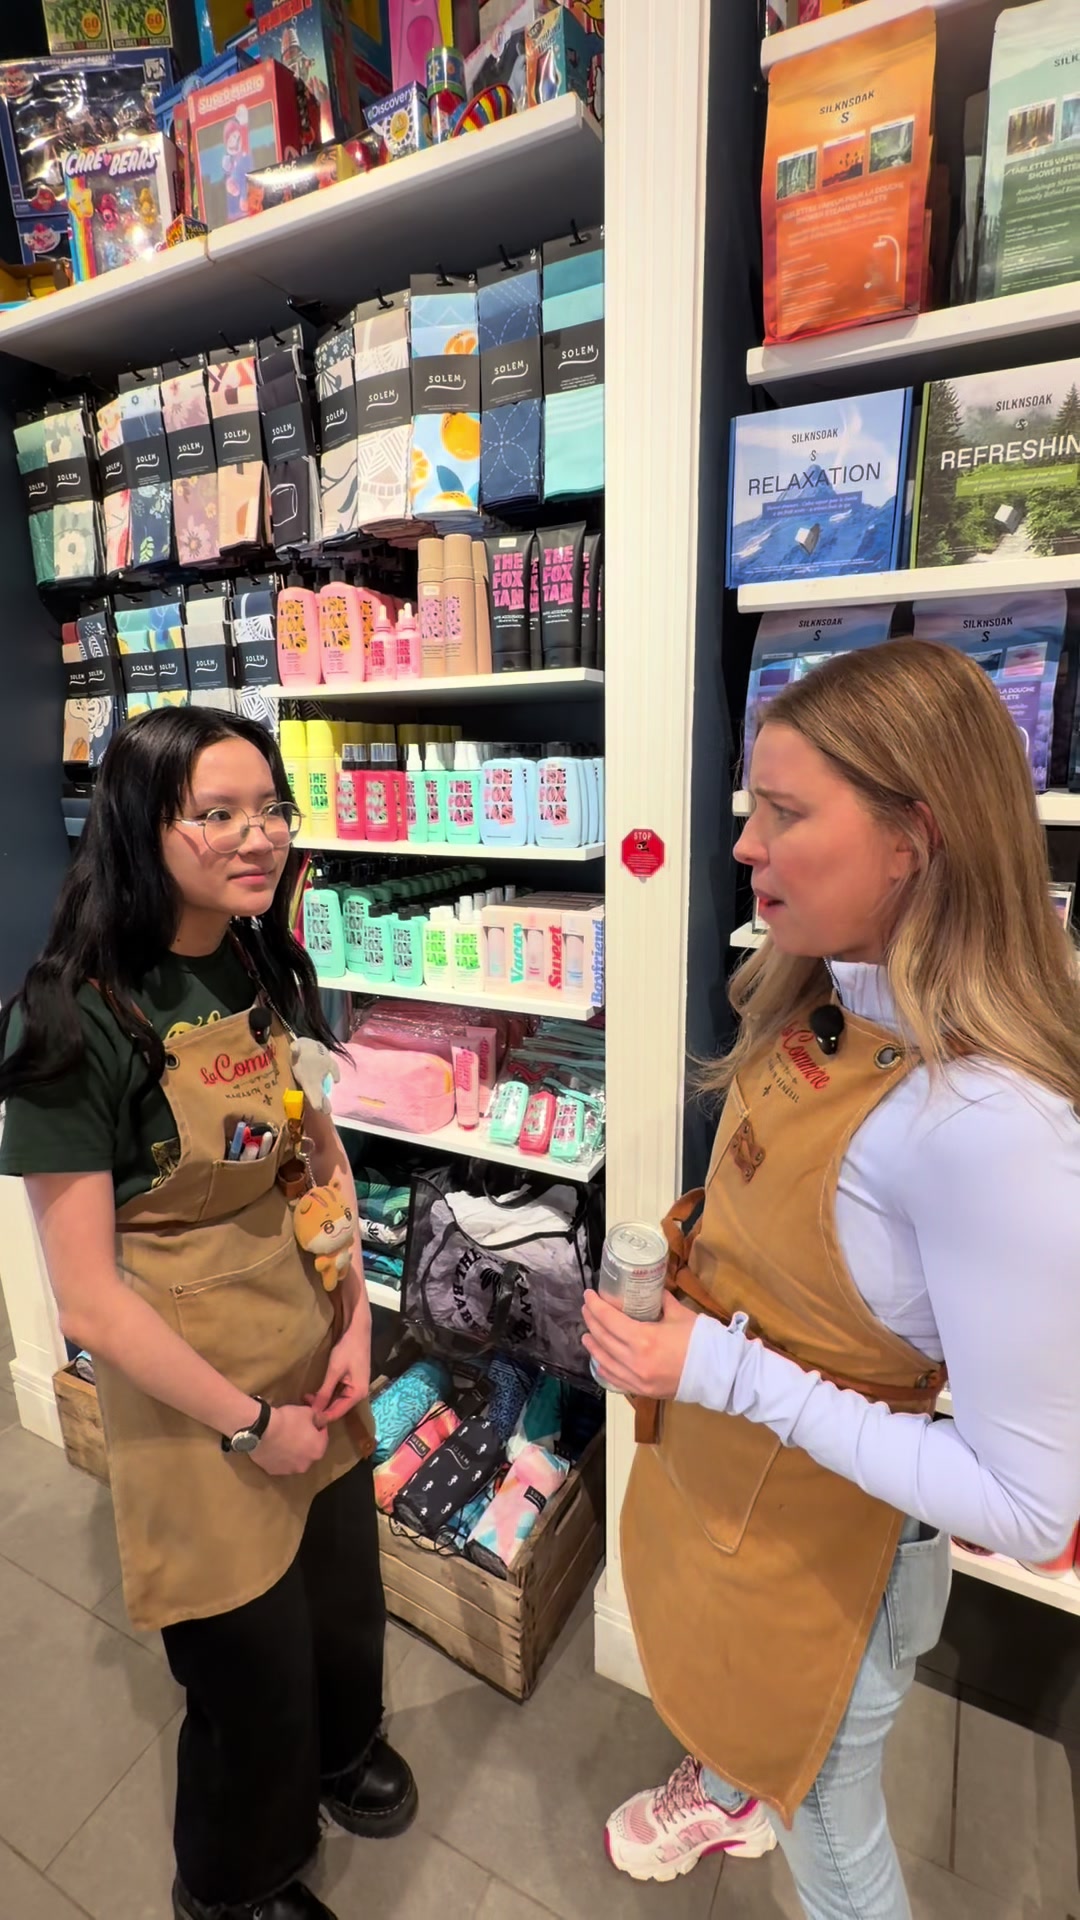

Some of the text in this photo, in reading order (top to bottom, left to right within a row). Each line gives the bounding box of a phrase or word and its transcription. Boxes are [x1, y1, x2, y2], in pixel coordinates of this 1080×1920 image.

[371, 88, 413, 117] Discovery
[820, 90, 875, 115] SILKNSOAK
[66, 146, 160, 176] CARE BEARS
[561, 345, 594, 359] SOLEM
[494, 360, 524, 375] SOLEM
[428, 374, 461, 384] SOLEM
[369, 389, 396, 402] SOLEM
[995, 393, 1053, 412] SILKNSOAK
[325, 408, 345, 423] SOLEM
[224, 430, 248, 440] SOLEM
[272, 423, 293, 436] SOLEM
[791, 428, 839, 444] SILKNSOAK
[178, 443, 200, 453] SOLEM
[136, 454, 156, 464] SOLEM
[57, 472, 78, 482] SOLEM
[748, 462, 881, 496] RELAXATION
[493, 552, 523, 571] THE
[544, 545, 573, 565] THE
[492, 571, 524, 589] FOX
[542, 564, 573, 584] FOX
[492, 589, 524, 610] TAN
[542, 583, 573, 605] TAN
[798, 617, 843, 628] SILKNSOAK
[963, 616, 1013, 629] SILKNSOAK
[159, 663, 176, 671] SOLEM
[196, 660, 215, 668] SOLEM
[245, 655, 265, 664] SOLEM
[1008, 686, 1035, 694] DOUCHE
[484, 768, 512, 784] THE
[540, 768, 566, 784] THE
[449, 780, 472, 793] THE
[484, 786, 513, 802] FOX
[540, 786, 567, 802] FOX
[448, 794, 473, 808] FOX
[484, 804, 513, 820] TAN
[540, 804, 568, 820] TAN
[634, 831, 652, 840] STOP
[307, 919, 331, 934] FOX
[510, 923, 524, 984] Vacay
[549, 925, 562, 990] Sweet
[591, 920, 604, 1005] Boyfriend
[200, 1066, 216, 1085] La
[450, 1444, 470, 1465] SOLEM
